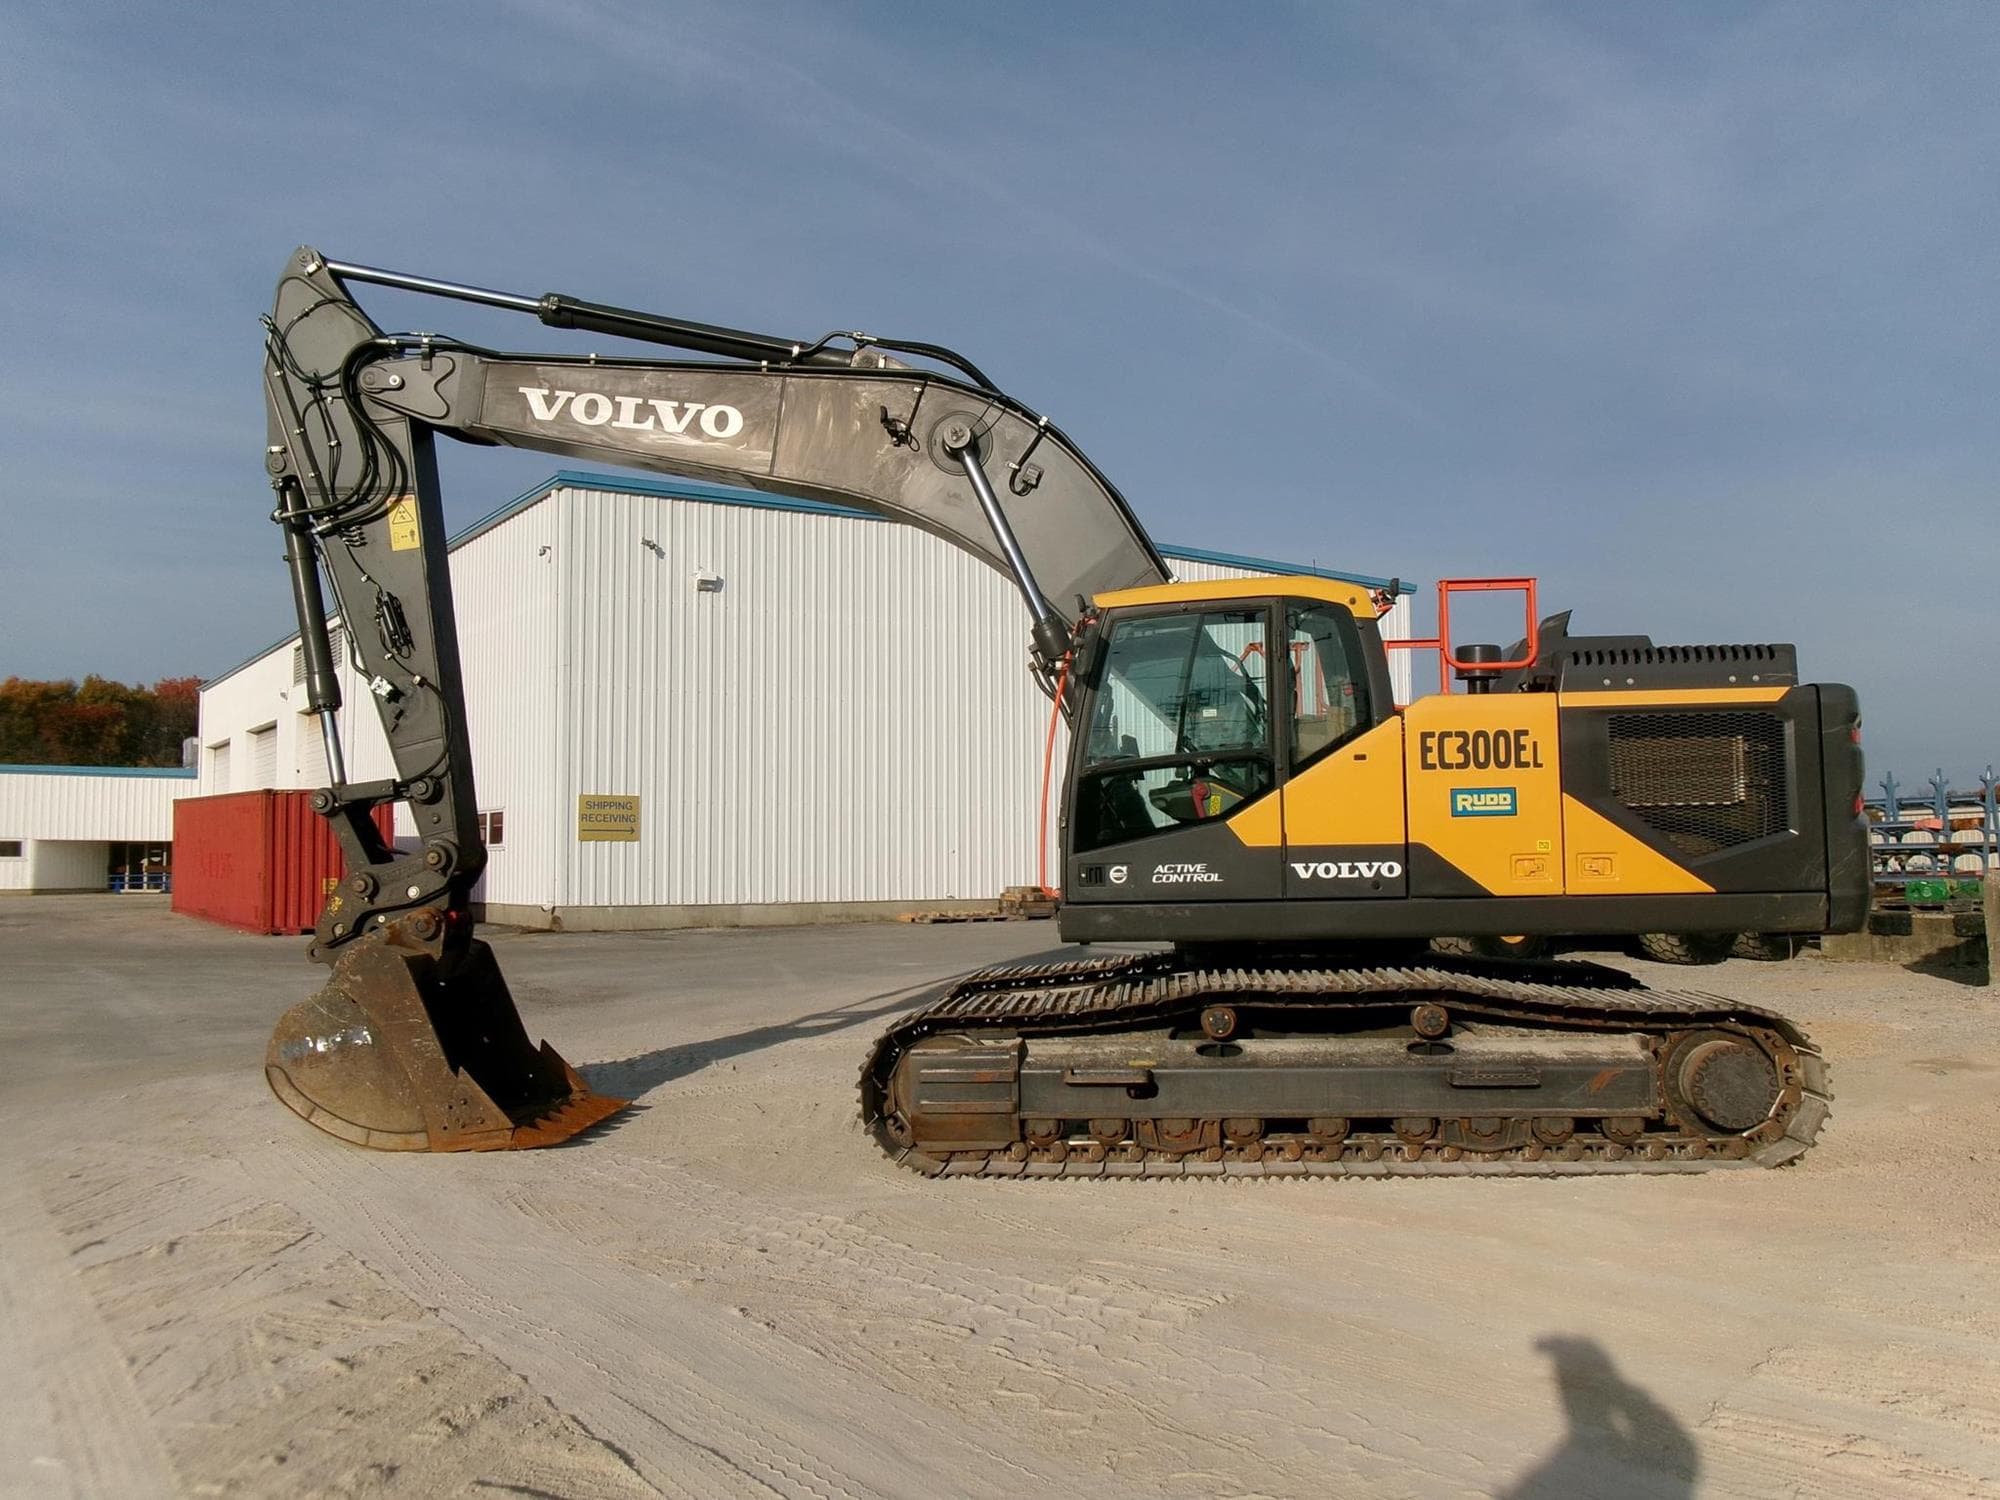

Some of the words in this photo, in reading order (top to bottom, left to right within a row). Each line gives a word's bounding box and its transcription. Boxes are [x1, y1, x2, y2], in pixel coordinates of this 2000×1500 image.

[518, 387, 744, 439] VOLVO
[1420, 729, 1544, 771] EC300EL
[585, 800, 633, 811] SHIPPING
[1456, 793, 1512, 812] RUDD
[580, 813, 637, 823] RECEIVING
[1153, 863, 1209, 873] ACTIVE
[1291, 861, 1403, 880] VOLVO
[1152, 873, 1224, 883] CONTROL
